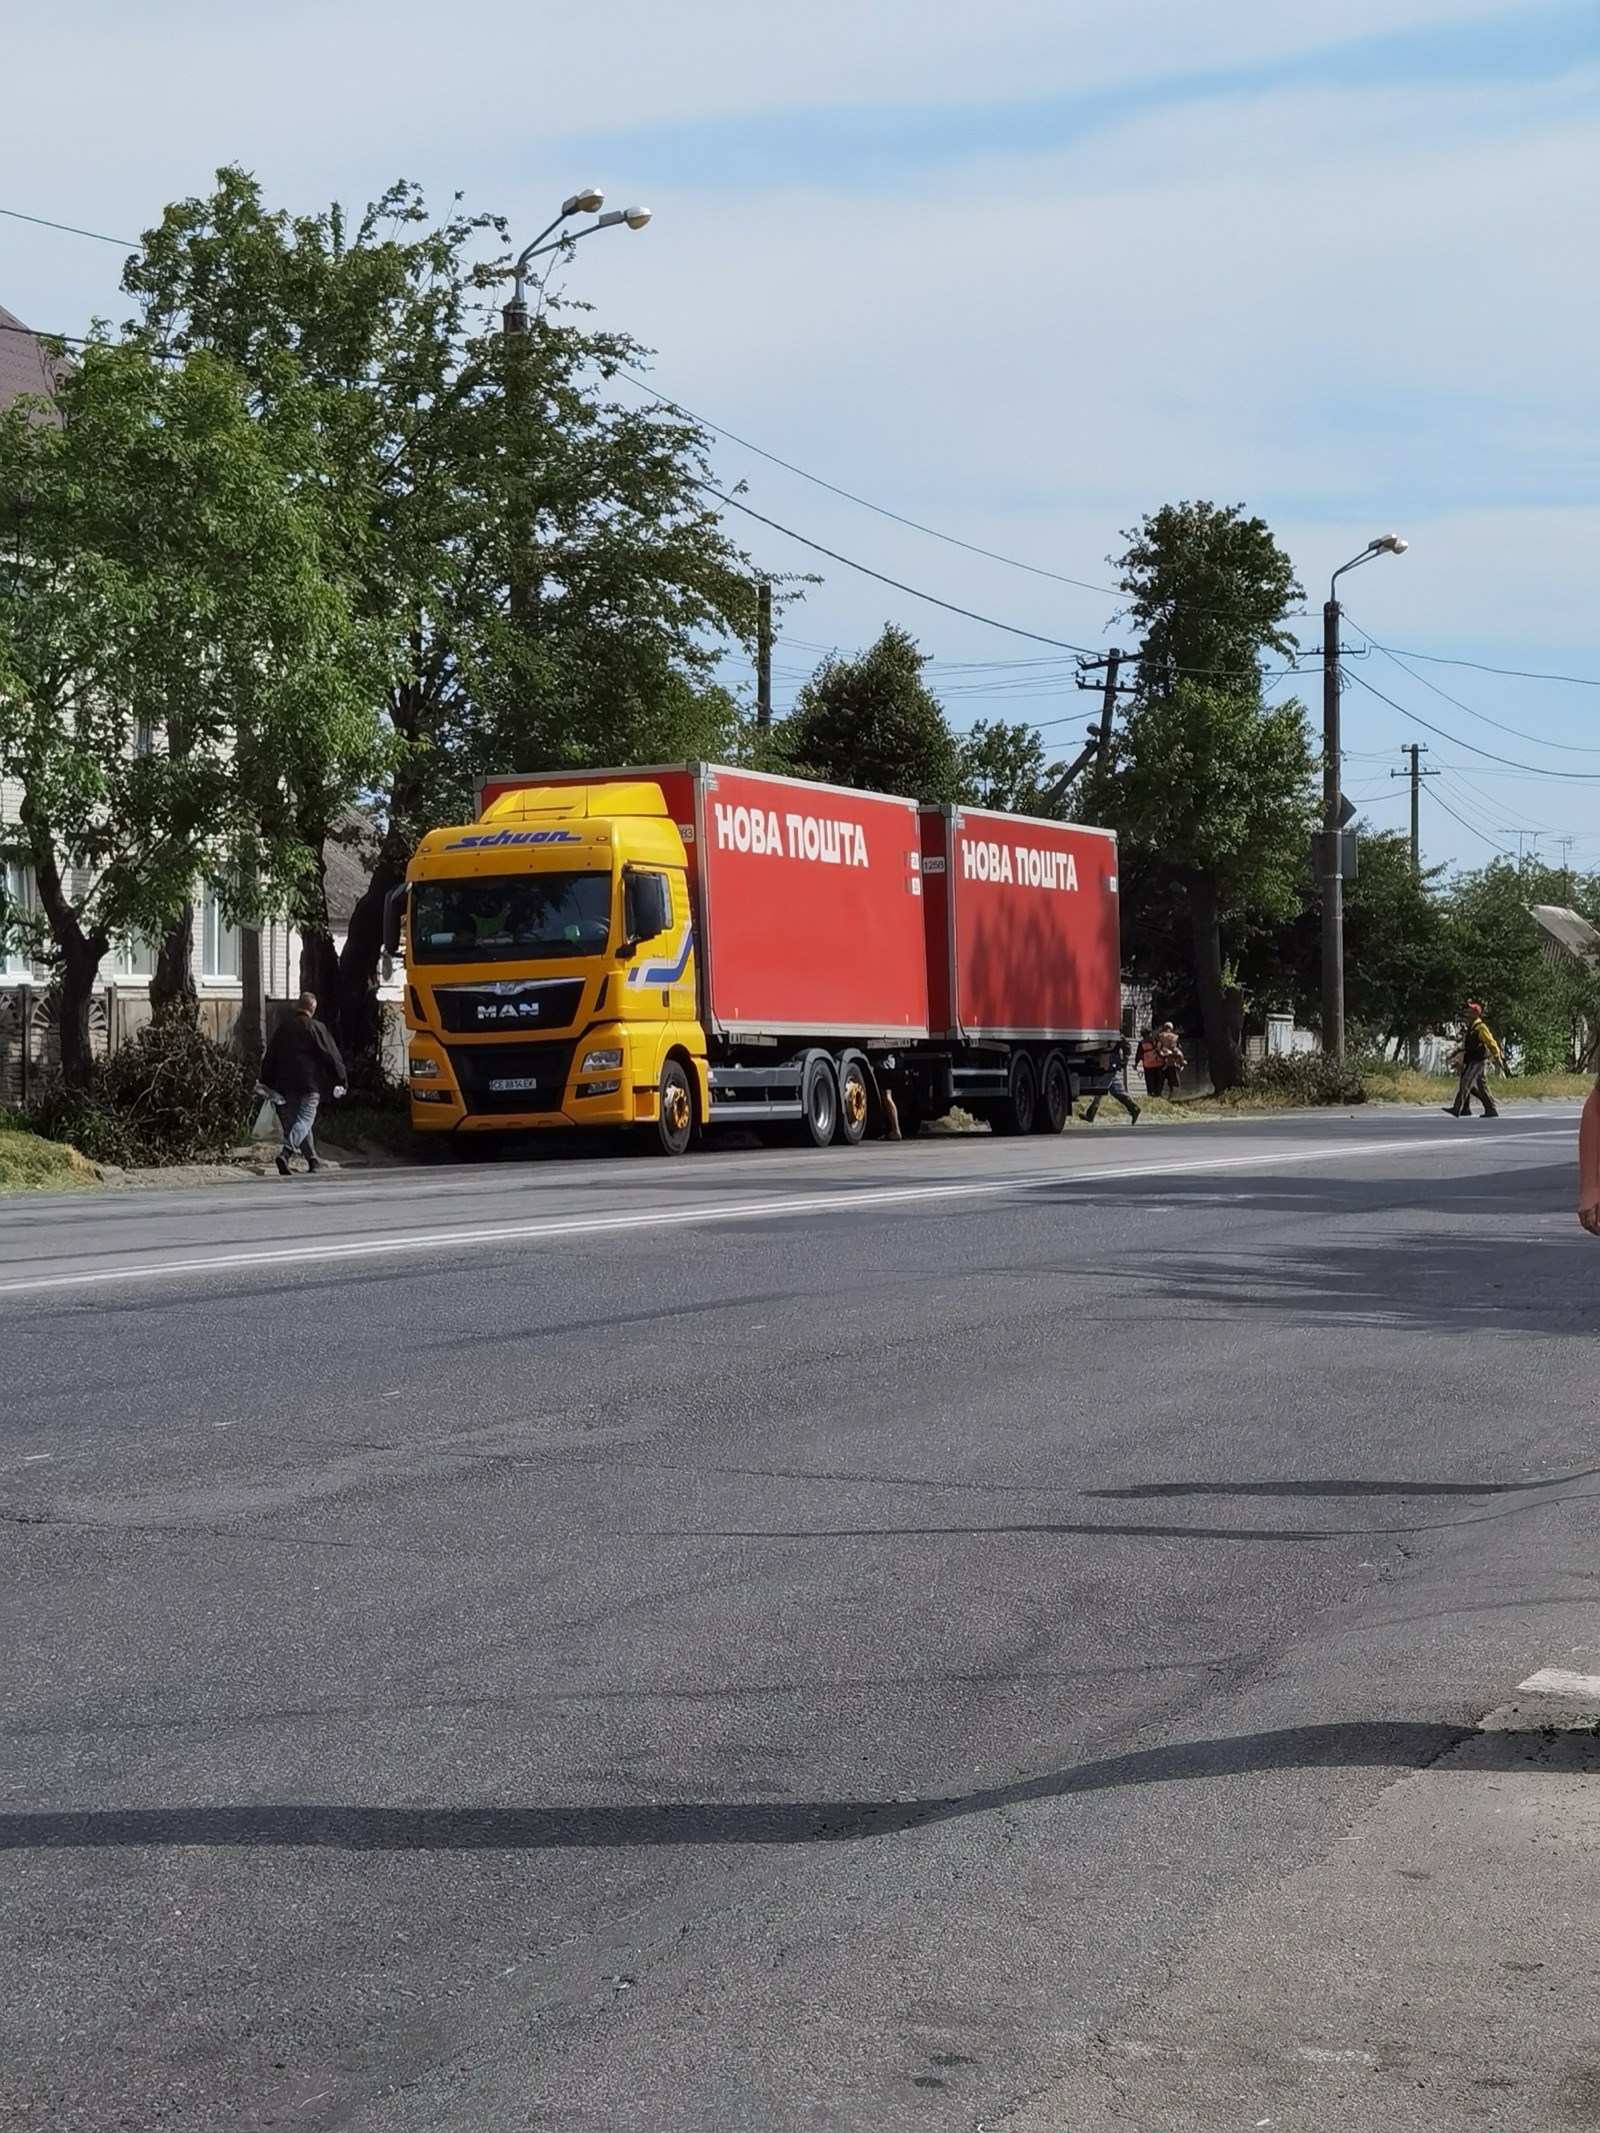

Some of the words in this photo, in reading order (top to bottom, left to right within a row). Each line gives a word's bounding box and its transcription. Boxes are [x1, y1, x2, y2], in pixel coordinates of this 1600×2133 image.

[714, 802, 784, 857] НОВА
[786, 813, 869, 868] ПОШТА
[961, 839, 1013, 884] НОВА
[1015, 846, 1079, 892] ПОШТА
[477, 1002, 539, 1019] MAN
